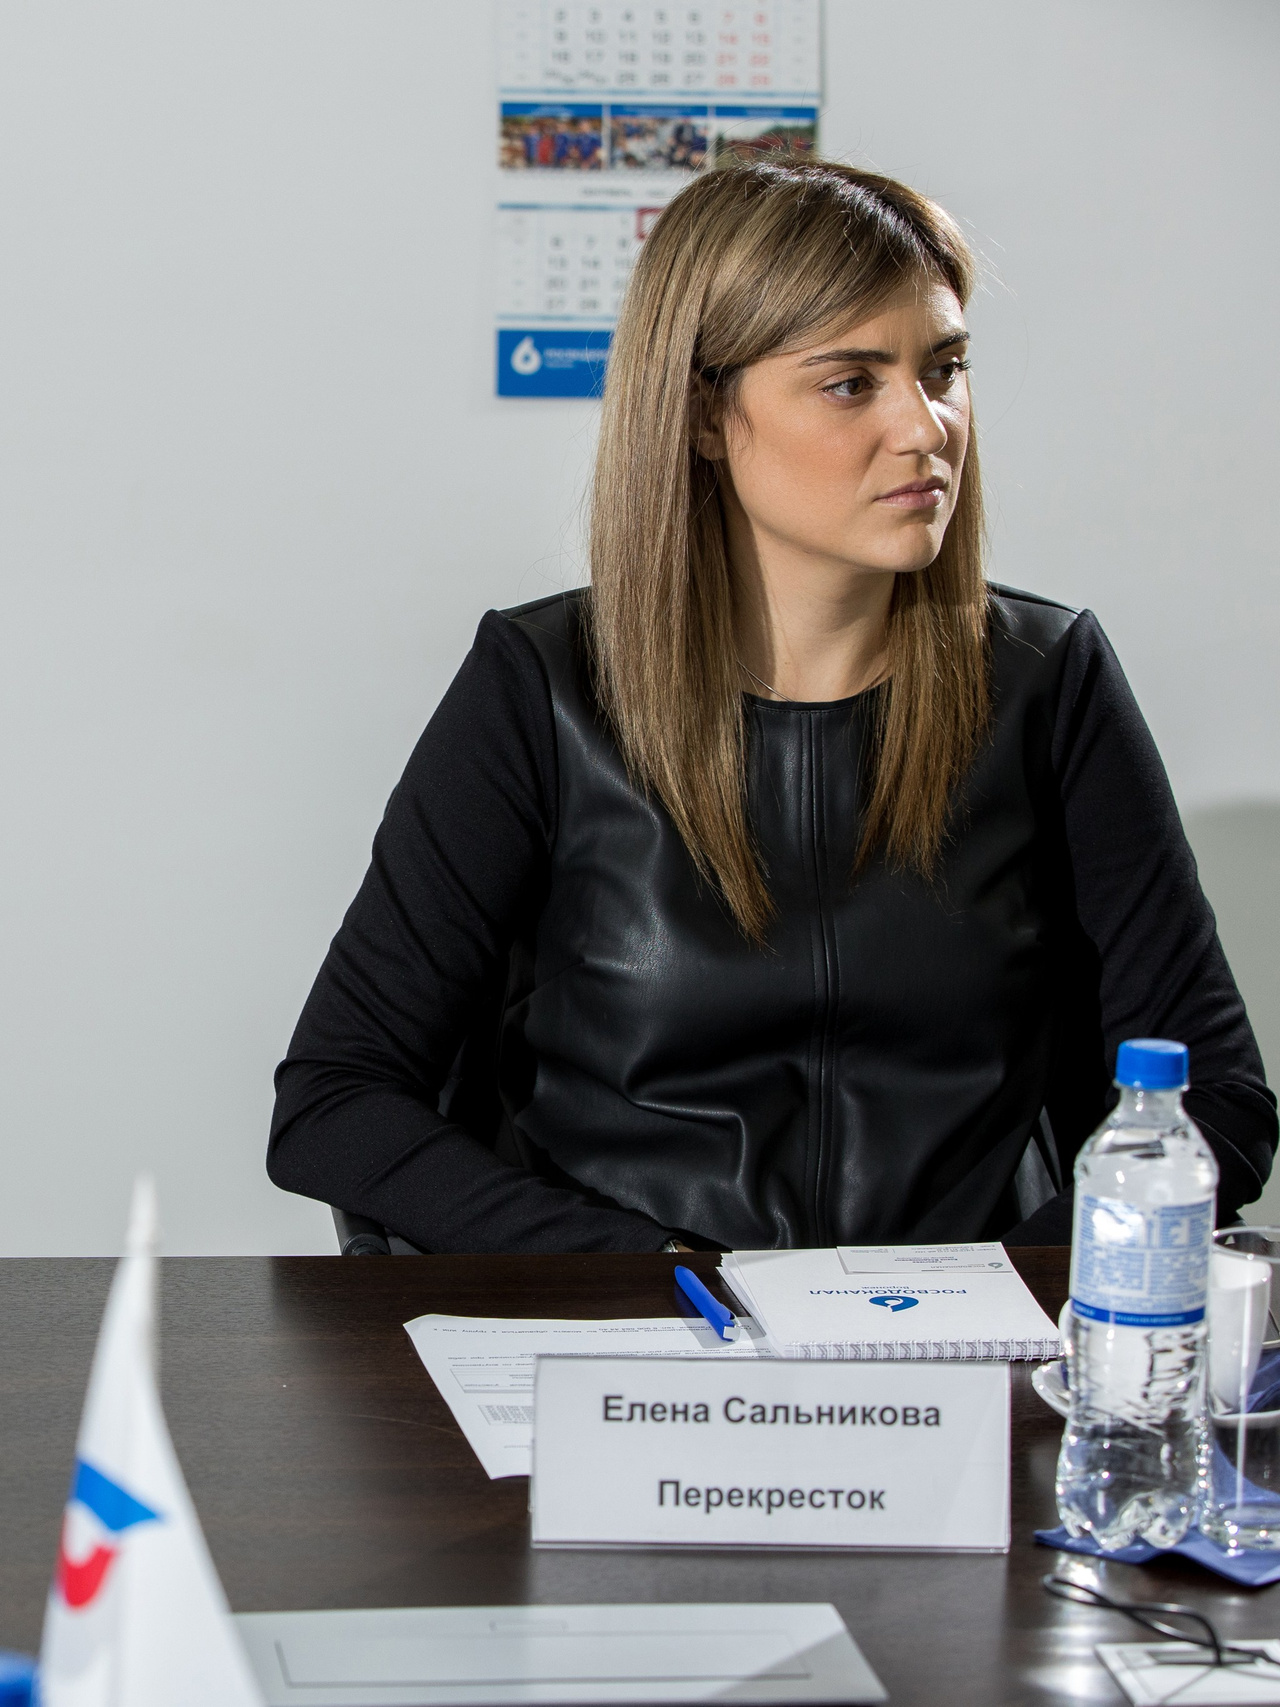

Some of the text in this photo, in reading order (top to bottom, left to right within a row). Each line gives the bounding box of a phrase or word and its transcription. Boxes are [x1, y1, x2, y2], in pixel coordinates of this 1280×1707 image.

[603, 1394, 941, 1427] Елена Сальникова
[658, 1479, 885, 1516] Перекресток
